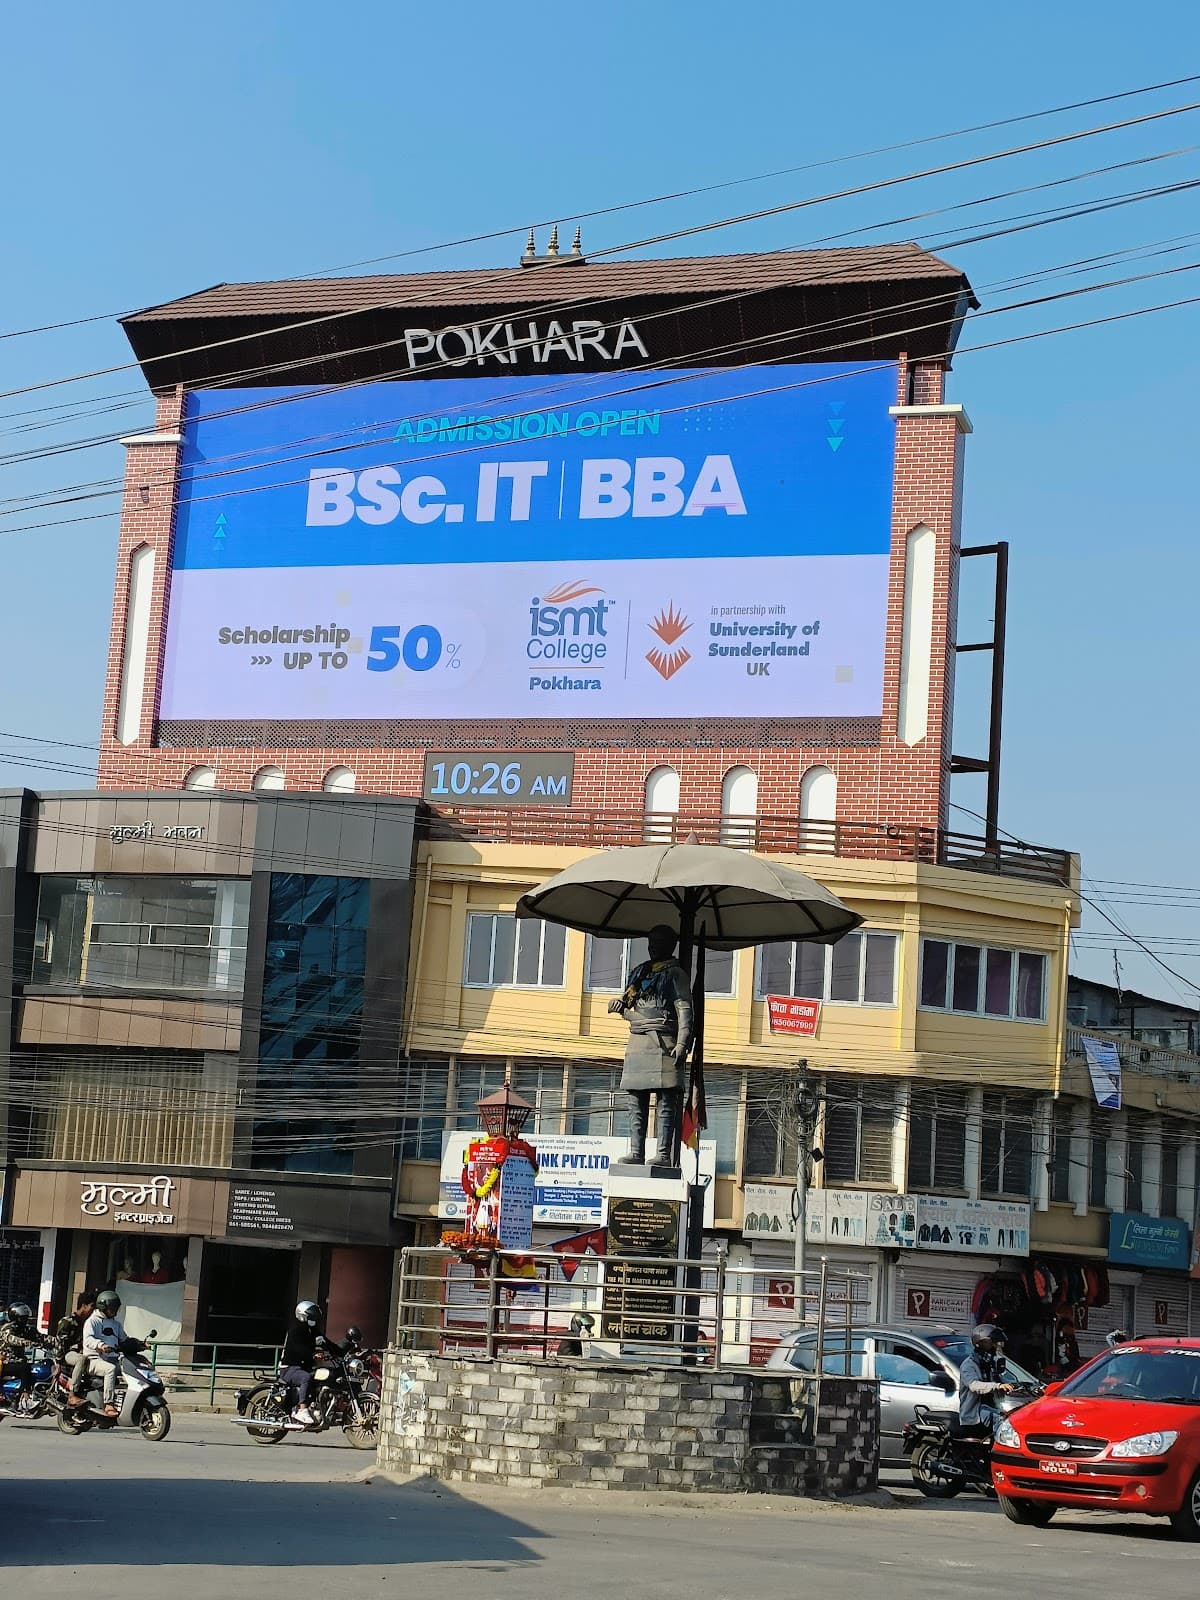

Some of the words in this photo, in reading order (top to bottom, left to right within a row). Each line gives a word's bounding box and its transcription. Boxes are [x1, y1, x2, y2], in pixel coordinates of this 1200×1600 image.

[403, 317, 649, 369] POKHARA
[393, 411, 569, 443] ADMISSION
[576, 409, 661, 437] OPEN
[305, 465, 465, 527] BSc.
[476, 461, 548, 522] IT
[579, 454, 748, 519] BBA
[529, 597, 609, 637] ismt
[711, 605, 719, 615] in
[720, 604, 766, 617] partnership
[768, 604, 786, 615] with
[218, 623, 350, 648] Scholarship
[710, 621, 797, 639] University
[801, 621, 821, 635] of
[527, 639, 607, 664] College
[708, 641, 810, 656] Sunderland
[284, 652, 313, 670] UP
[318, 652, 349, 669] TO
[747, 662, 770, 676] UK
[529, 676, 602, 690] Pokhara
[431, 762, 521, 795] 10:26
[529, 775, 567, 796] AM
[562, 1154, 610, 1169] PVT.LTD
[80, 1175, 176, 1216] मुल्मी
[871, 1198, 915, 1212] SALE
